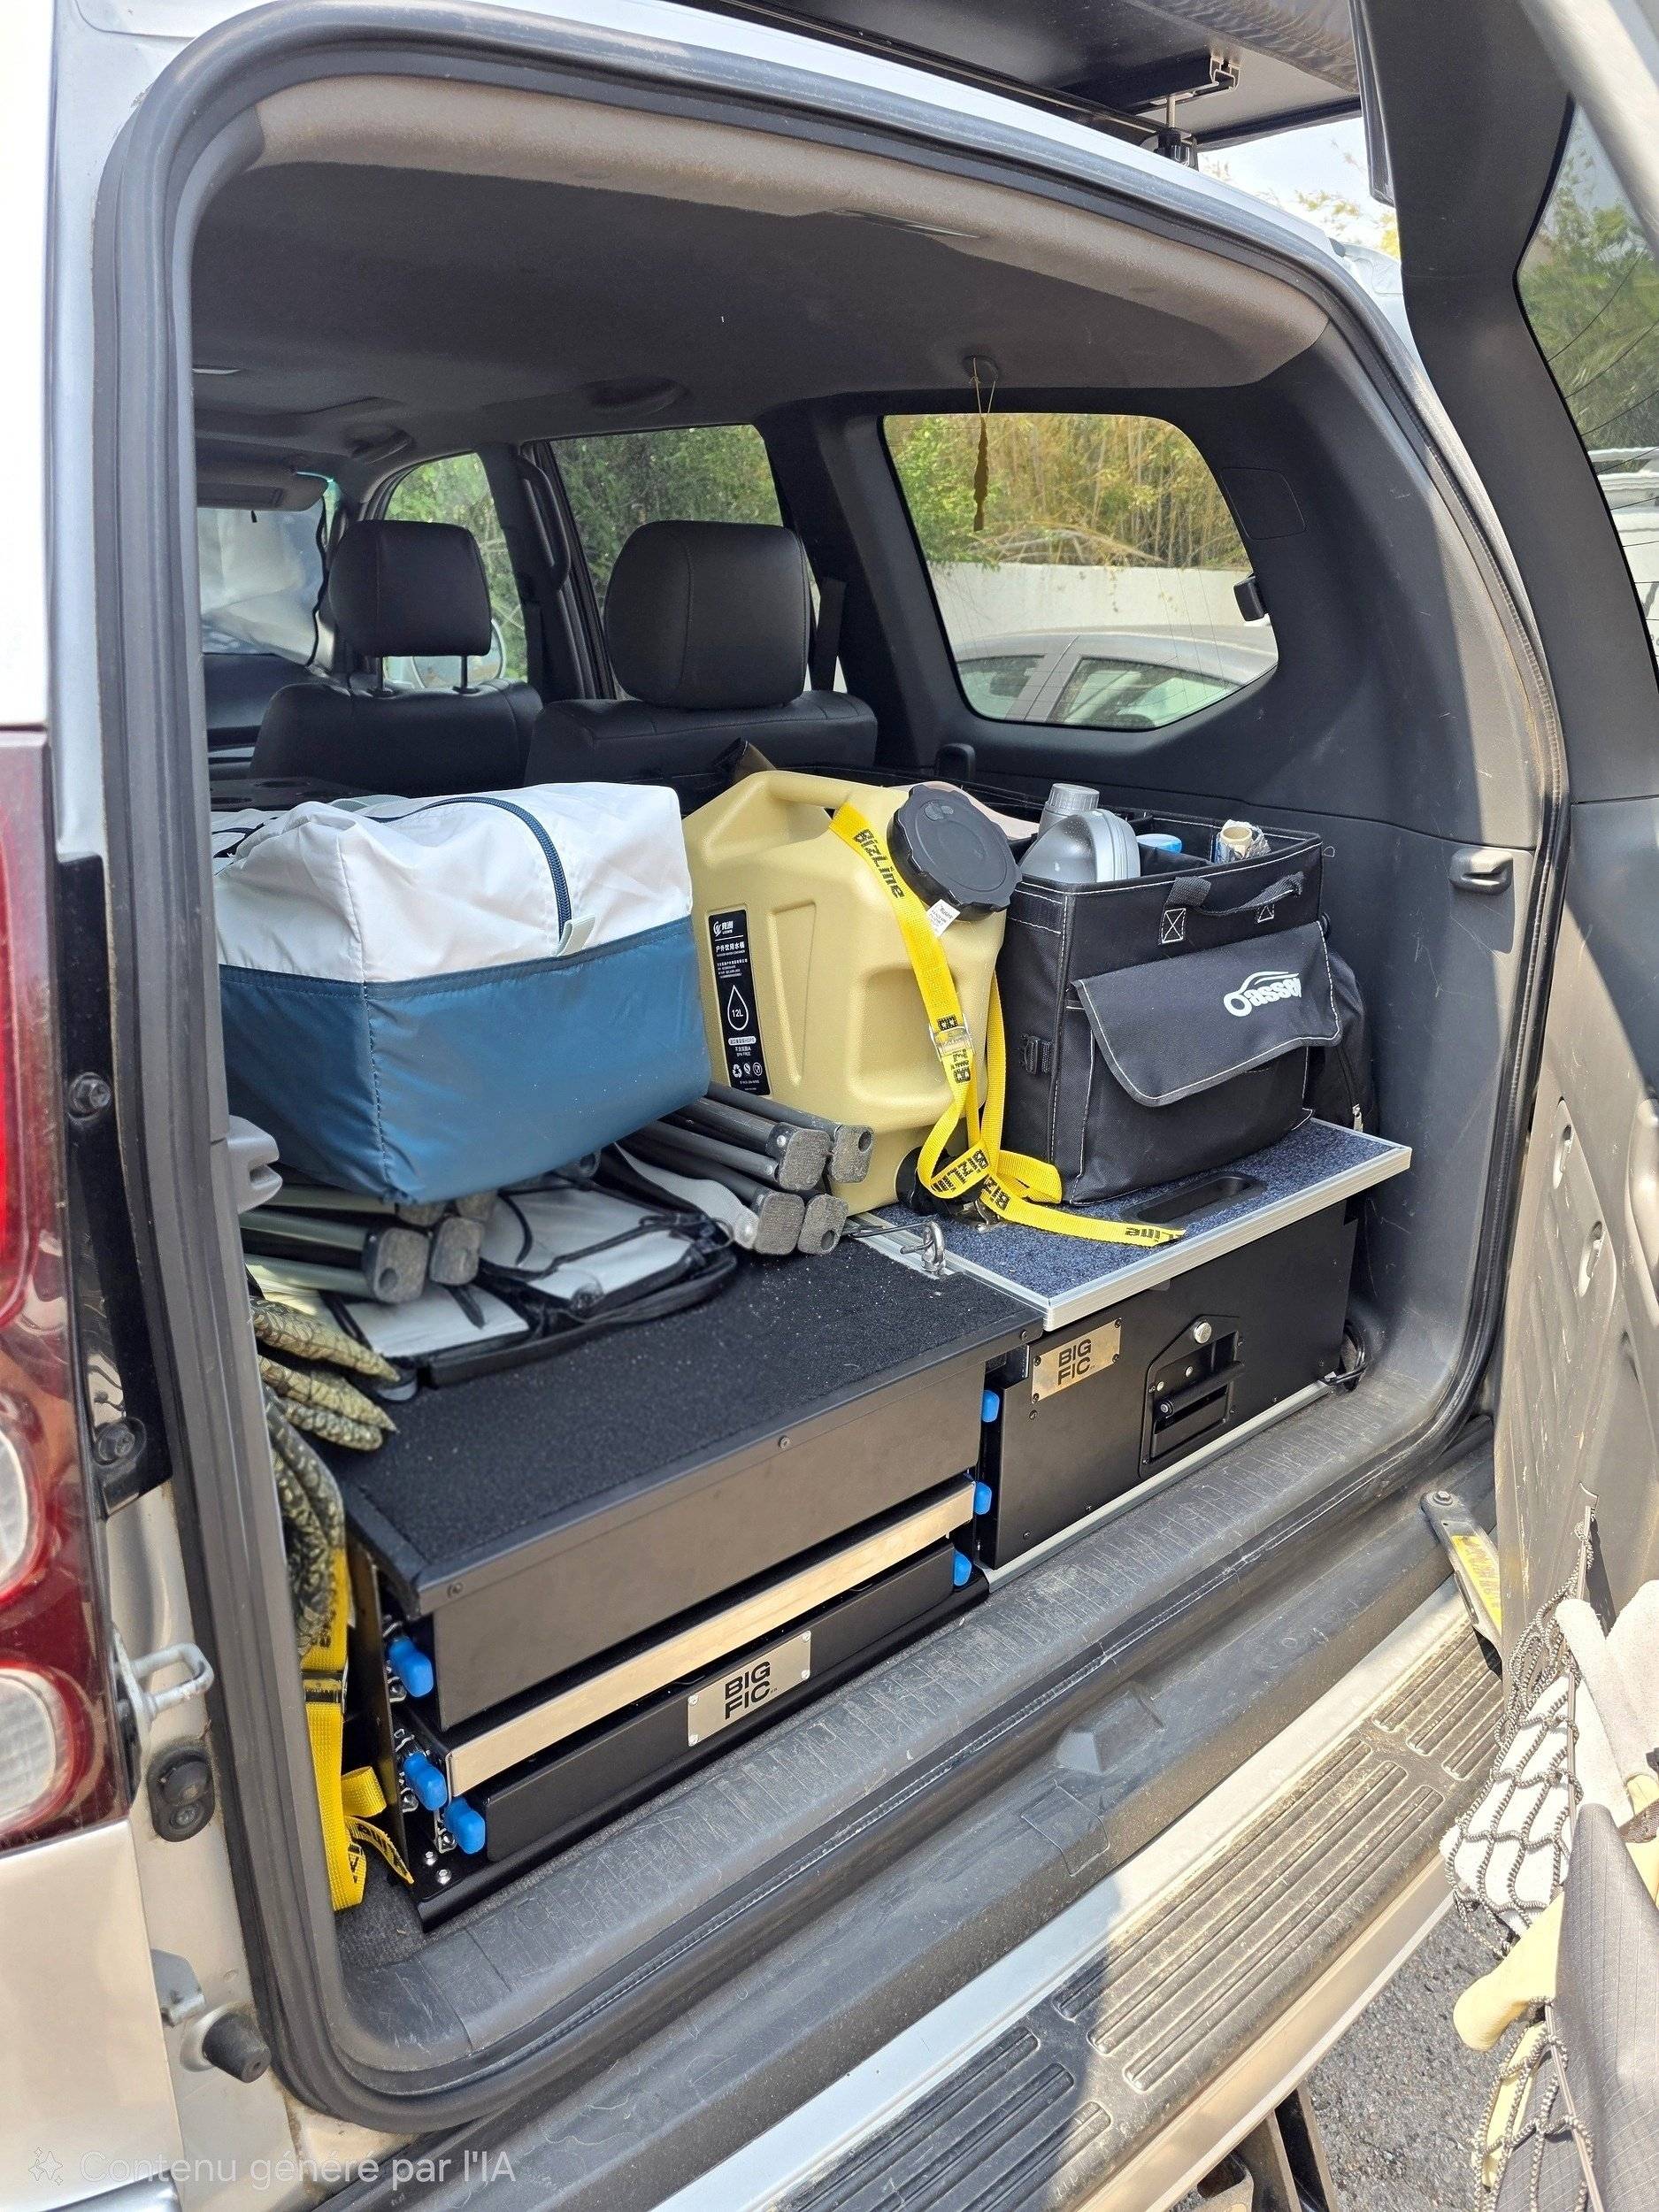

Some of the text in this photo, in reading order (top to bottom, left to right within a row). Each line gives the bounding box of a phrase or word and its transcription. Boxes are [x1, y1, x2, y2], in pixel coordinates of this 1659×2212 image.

[852, 828, 905, 898] BizLine
[732, 1009, 744, 1018] 12L
[930, 1148, 987, 1193] BizLin
[1057, 1357, 1090, 1386] FIC
[1058, 1339, 1091, 1367] BIG
[725, 1661, 771, 1701] BIG
[725, 1681, 770, 1720] FIC
